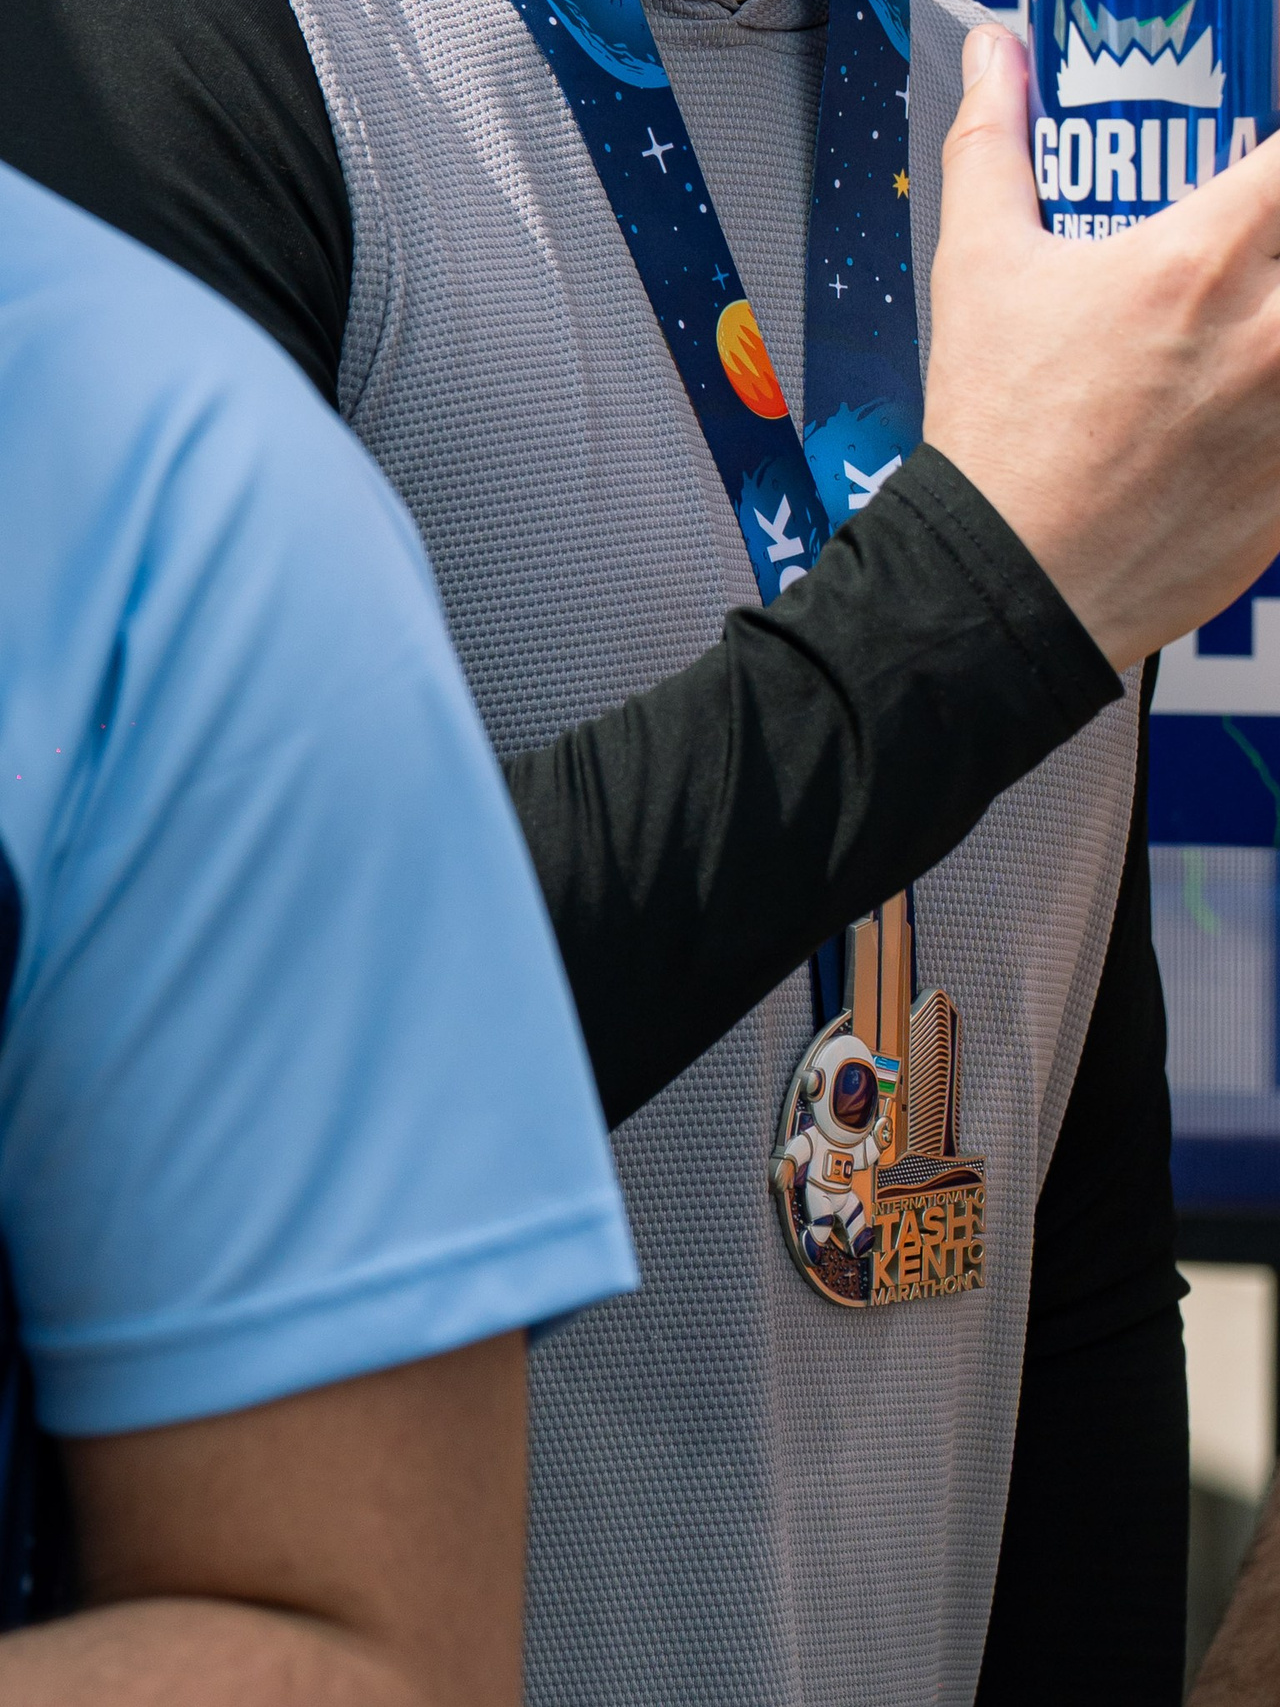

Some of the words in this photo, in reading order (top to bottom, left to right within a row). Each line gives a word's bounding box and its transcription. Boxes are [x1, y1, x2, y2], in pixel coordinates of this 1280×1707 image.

[872, 1189, 971, 1215] INTERNATIONAL
[873, 1200, 973, 1253] TASH
[872, 1238, 973, 1290] KENT
[870, 1274, 973, 1306] MARATHON
